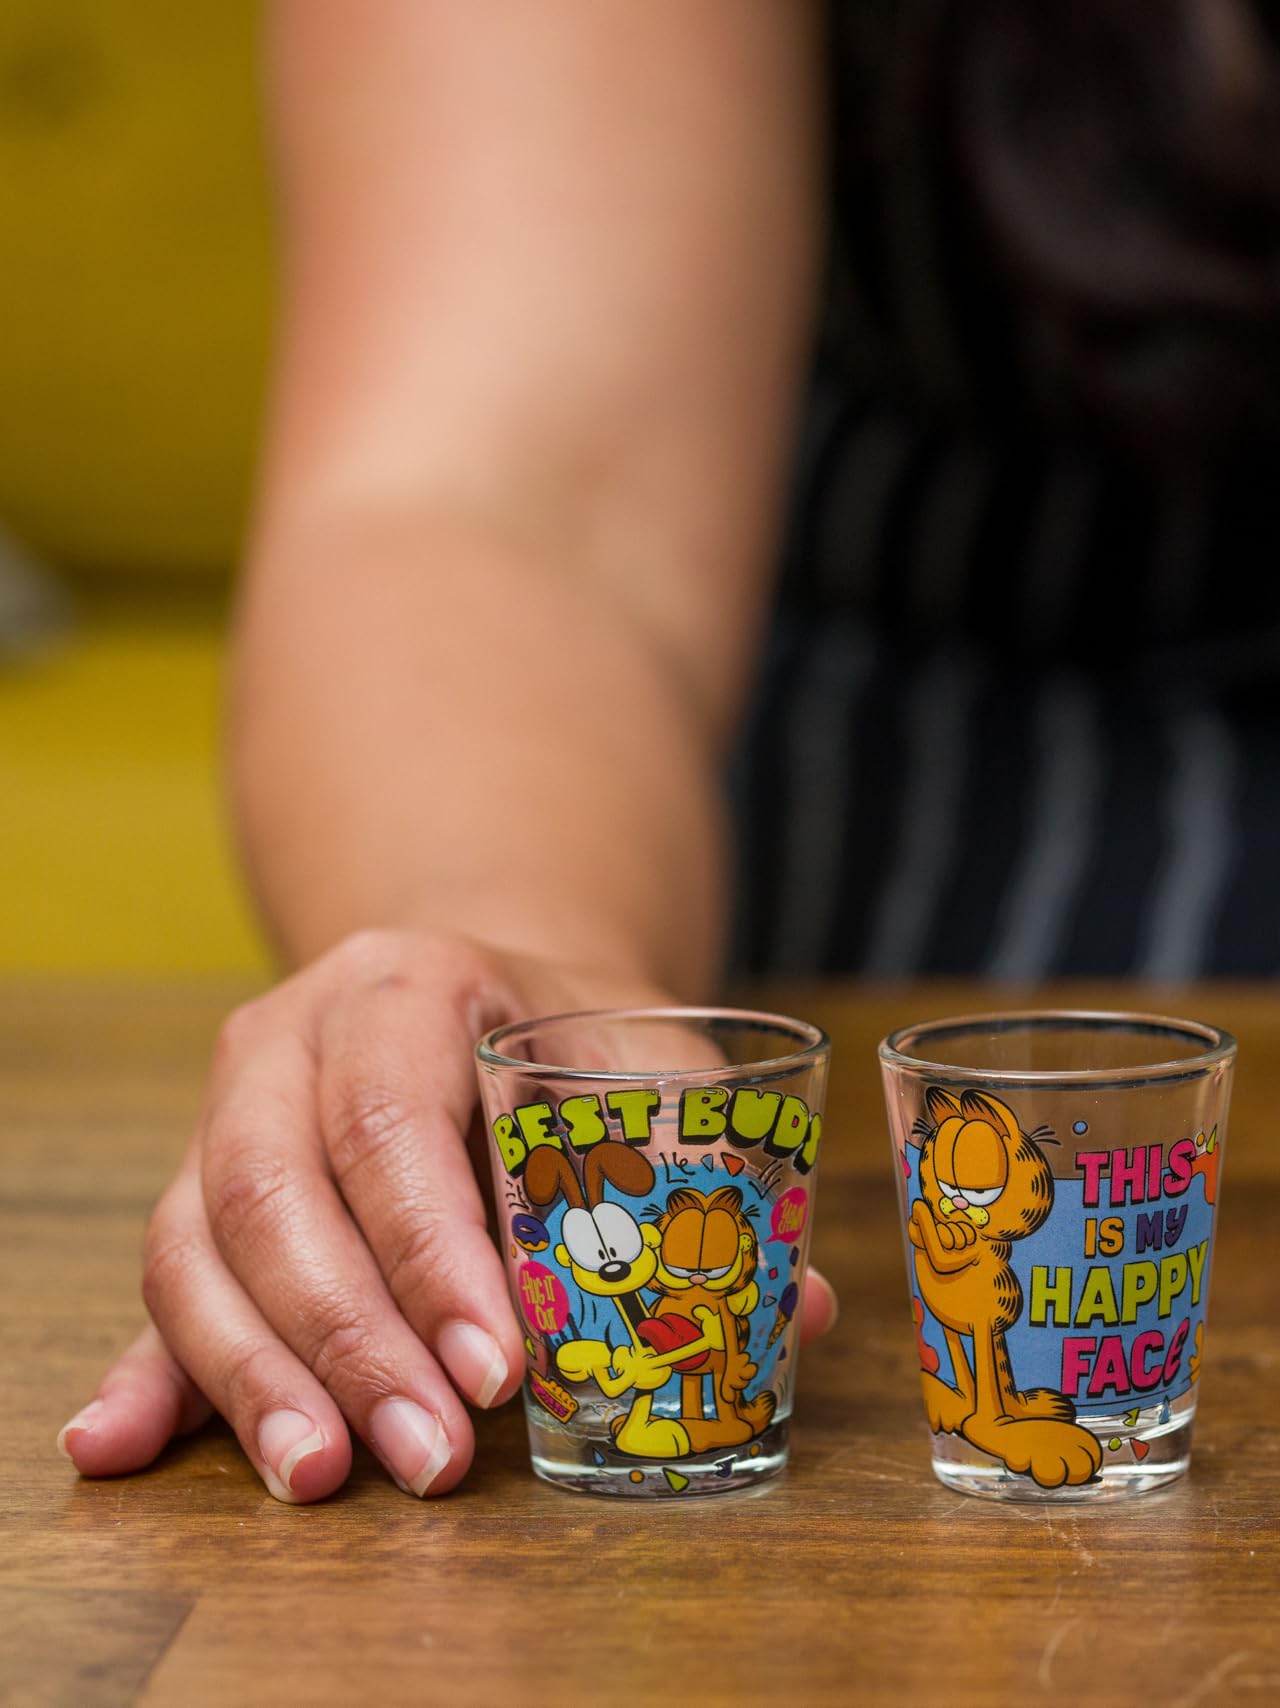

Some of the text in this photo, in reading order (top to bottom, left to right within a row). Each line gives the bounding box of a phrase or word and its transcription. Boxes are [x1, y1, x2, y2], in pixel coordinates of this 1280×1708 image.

[493, 1088, 661, 1179] BEST
[1075, 1138, 1199, 1209] THIS
[1084, 1204, 1189, 1259] IS MY
[1028, 1239, 1209, 1328] HAPPY
[1060, 1317, 1191, 1399] FACE
